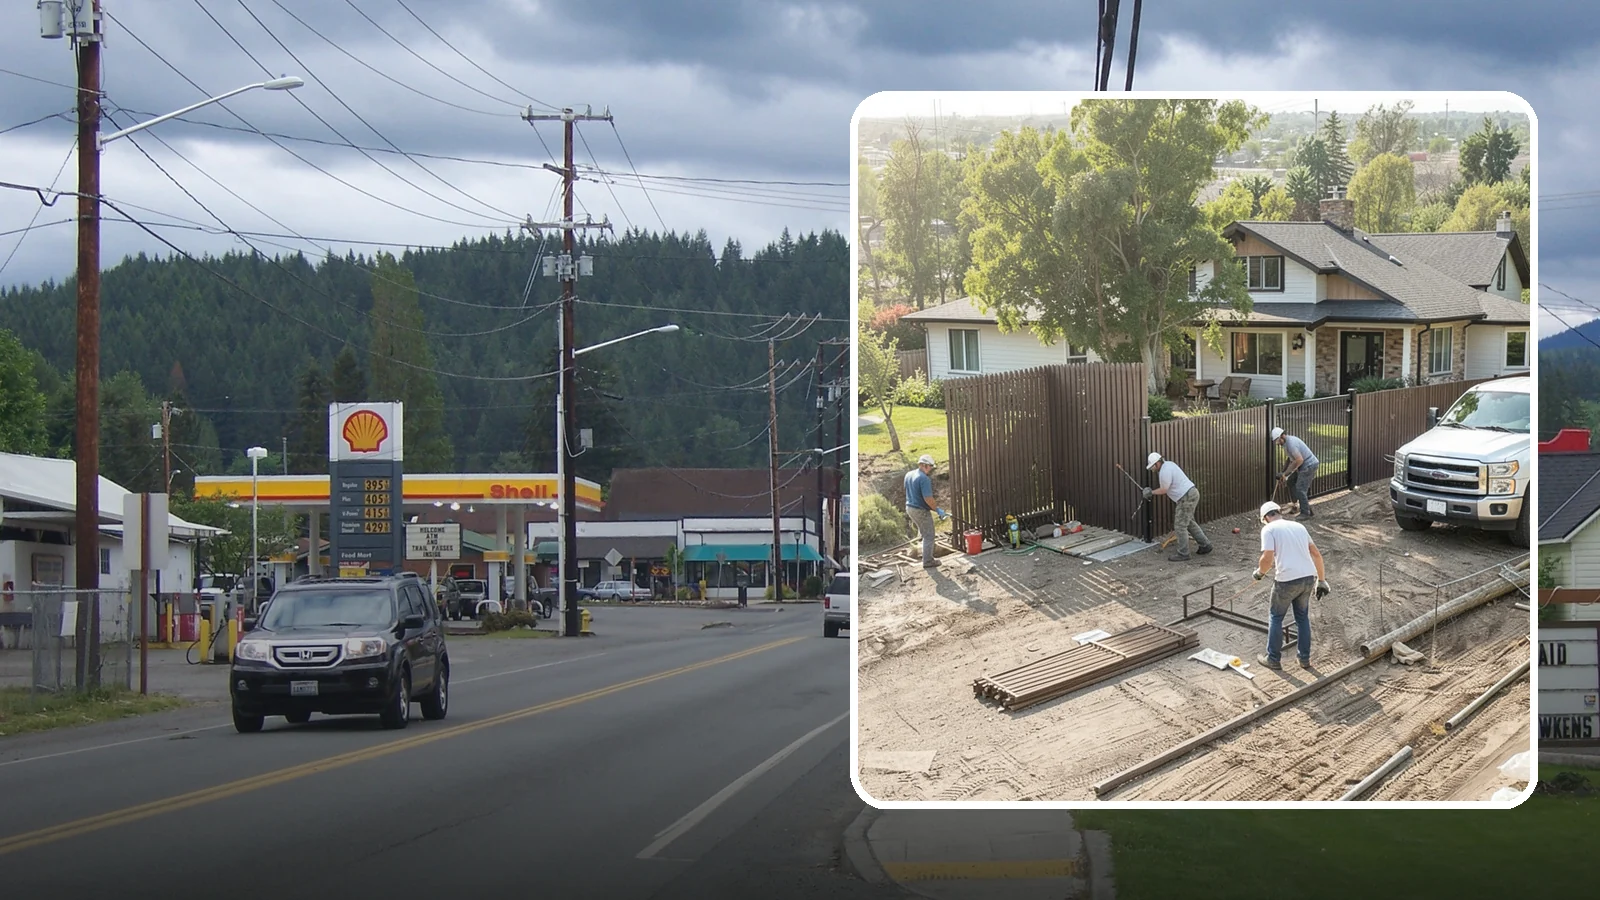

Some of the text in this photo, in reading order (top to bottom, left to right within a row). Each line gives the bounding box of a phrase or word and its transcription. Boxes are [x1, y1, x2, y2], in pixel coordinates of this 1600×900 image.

[366, 480, 383, 490] 395
[490, 484, 547, 499] Shell
[366, 494, 383, 504] 405
[366, 508, 383, 518] 415
[366, 522, 383, 533] 429
